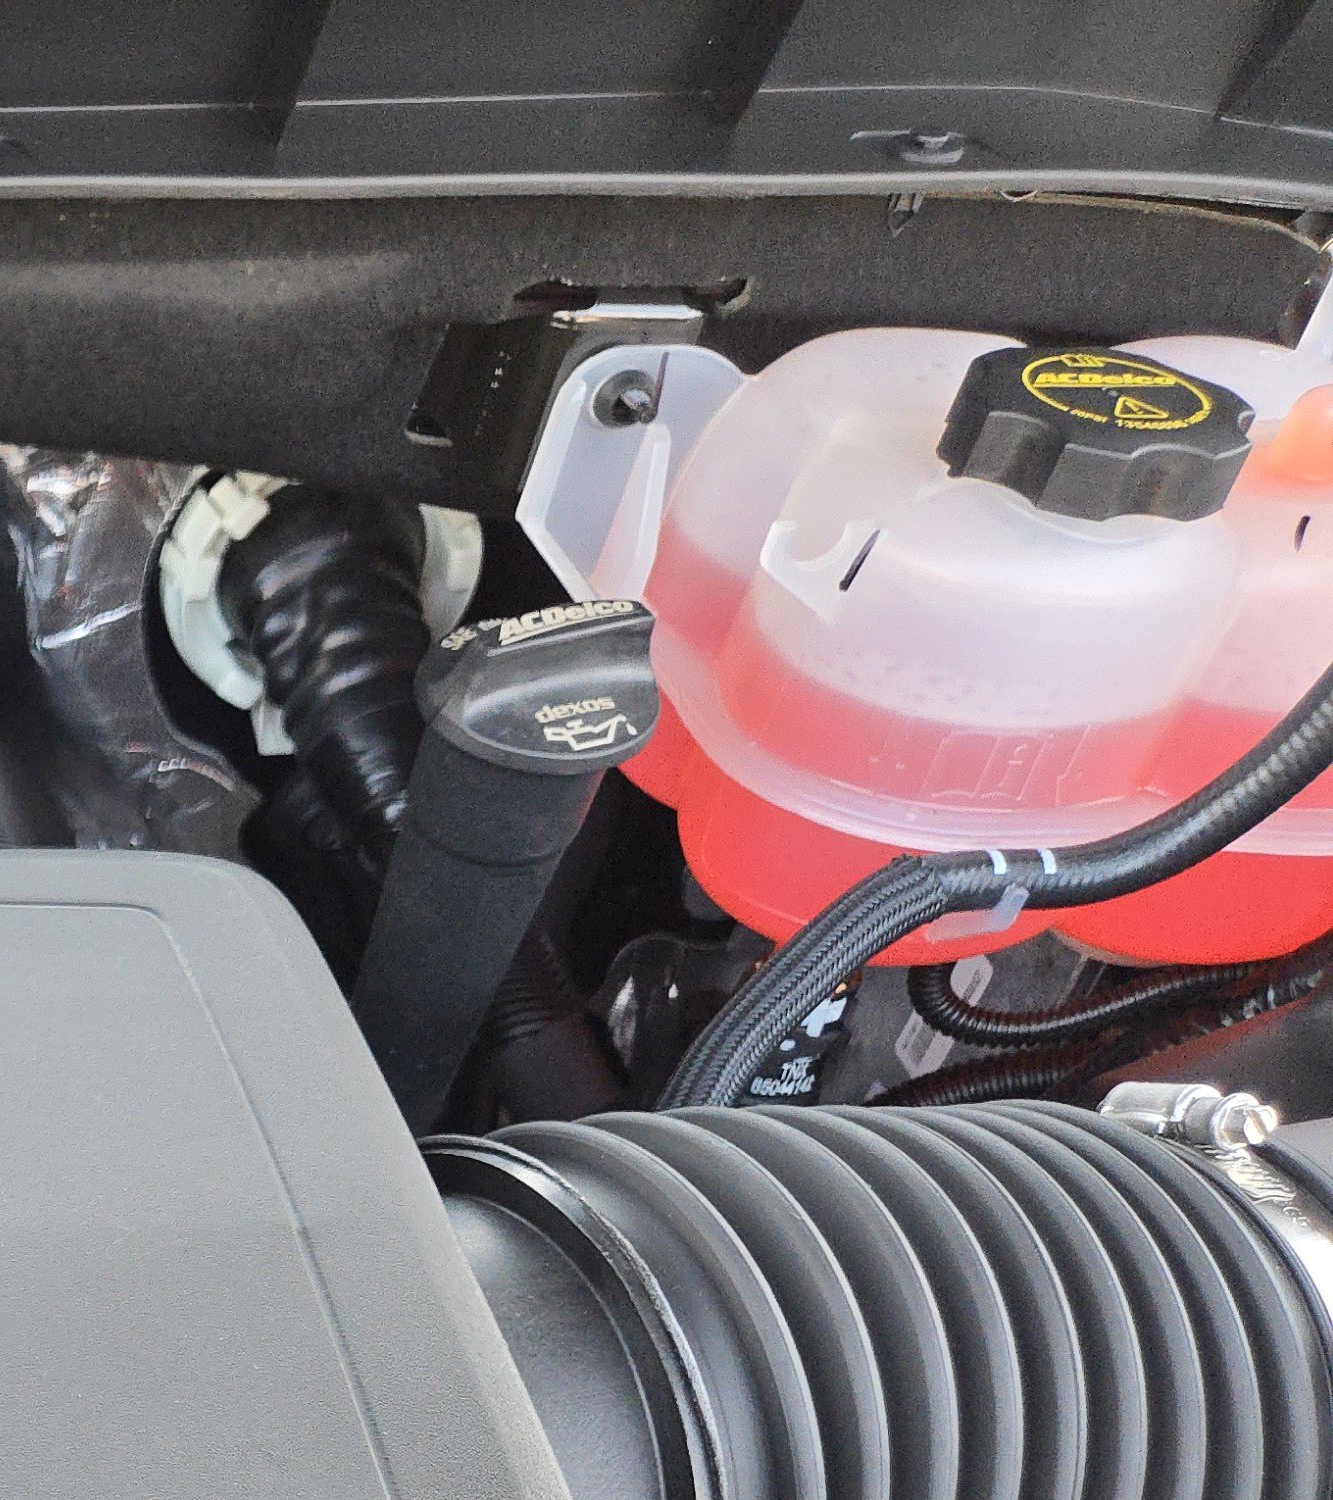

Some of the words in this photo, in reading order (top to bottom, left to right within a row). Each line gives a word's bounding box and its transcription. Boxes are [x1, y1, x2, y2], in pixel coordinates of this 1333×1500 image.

[1035, 372, 1177, 386] ACDelco
[500, 601, 634, 641] ACDelco
[535, 696, 616, 723] dexos
